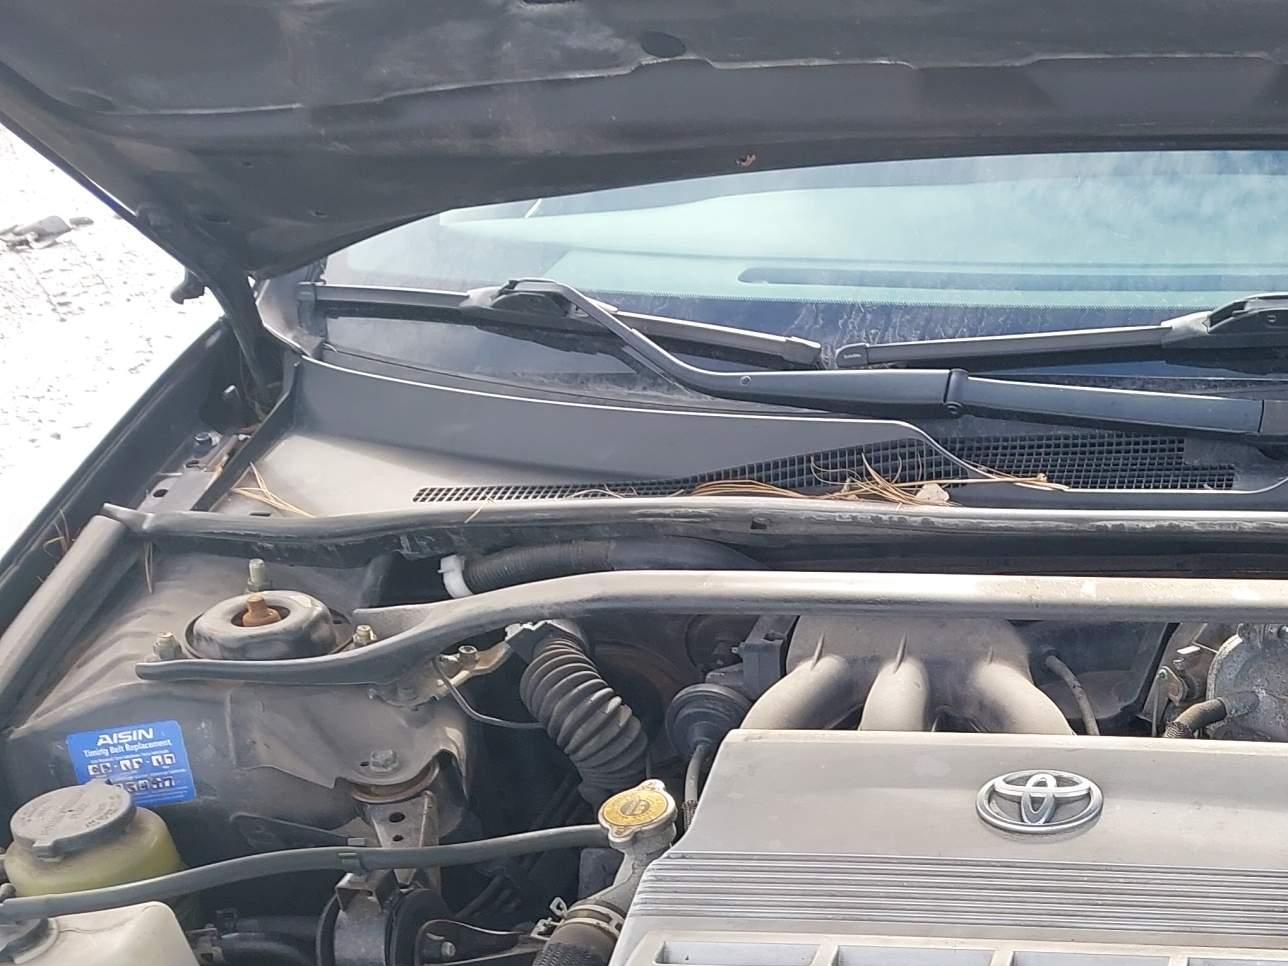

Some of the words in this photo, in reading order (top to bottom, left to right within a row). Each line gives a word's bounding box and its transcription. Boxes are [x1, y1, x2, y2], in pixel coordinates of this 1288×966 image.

[97, 728, 154, 746] AISIN
[82, 747, 109, 758] Timing
[109, 744, 125, 754] Belt
[125, 739, 172, 753] Replacement
